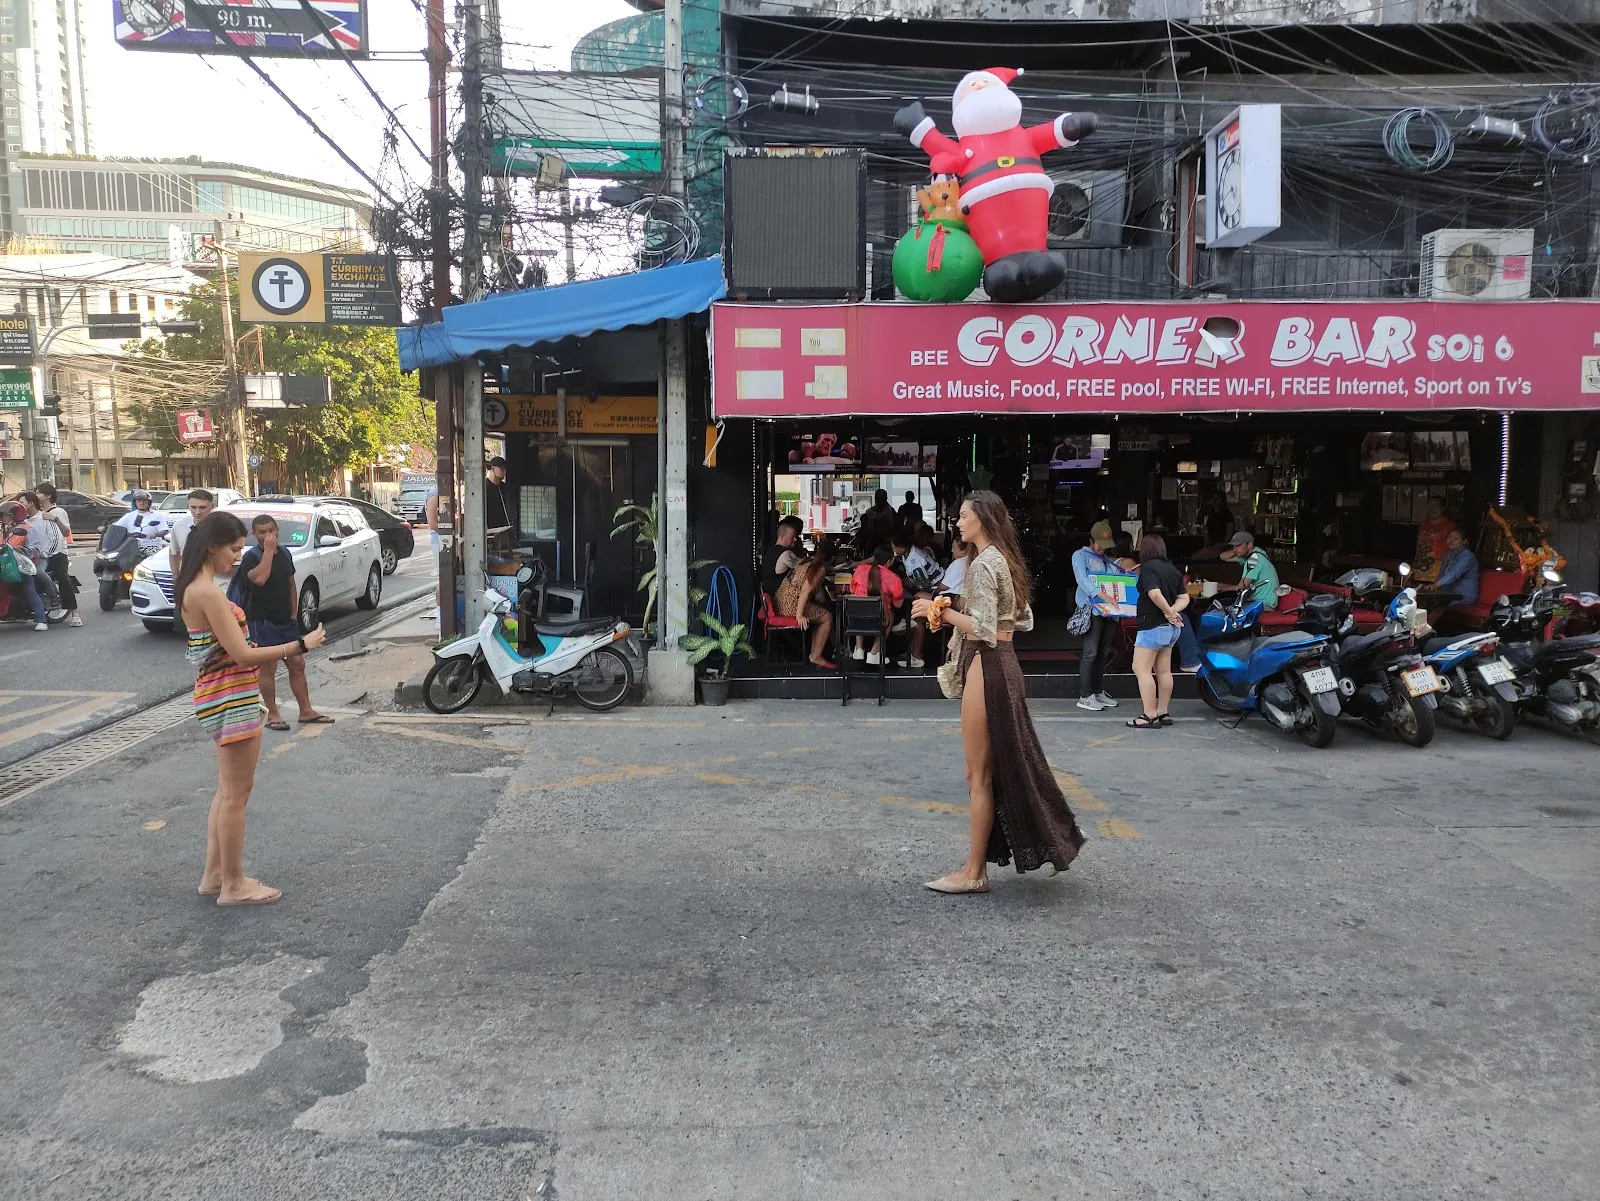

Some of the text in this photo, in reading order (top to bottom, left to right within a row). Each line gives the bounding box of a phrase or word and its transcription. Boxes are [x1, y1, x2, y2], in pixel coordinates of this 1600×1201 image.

[217, 9, 273, 29] 90 m.
[330, 257, 346, 265] T.T.
[331, 265, 386, 273] CURRENCY
[331, 273, 387, 282] EXCHANGE
[809, 337, 821, 347] You
[1269, 315, 1417, 369] BAR
[1494, 334, 1515, 362] 6
[910, 350, 949, 366] BEE
[892, 376, 1532, 401] Great Music, Food, FREE pool, FREE WI-FI, FREE Internet, Sport on Tv's
[518, 400, 536, 409] T.T.
[518, 409, 584, 419] CURRECY
[518, 419, 584, 428] EXCHAGE
[1414, 682, 1435, 693] 9021
